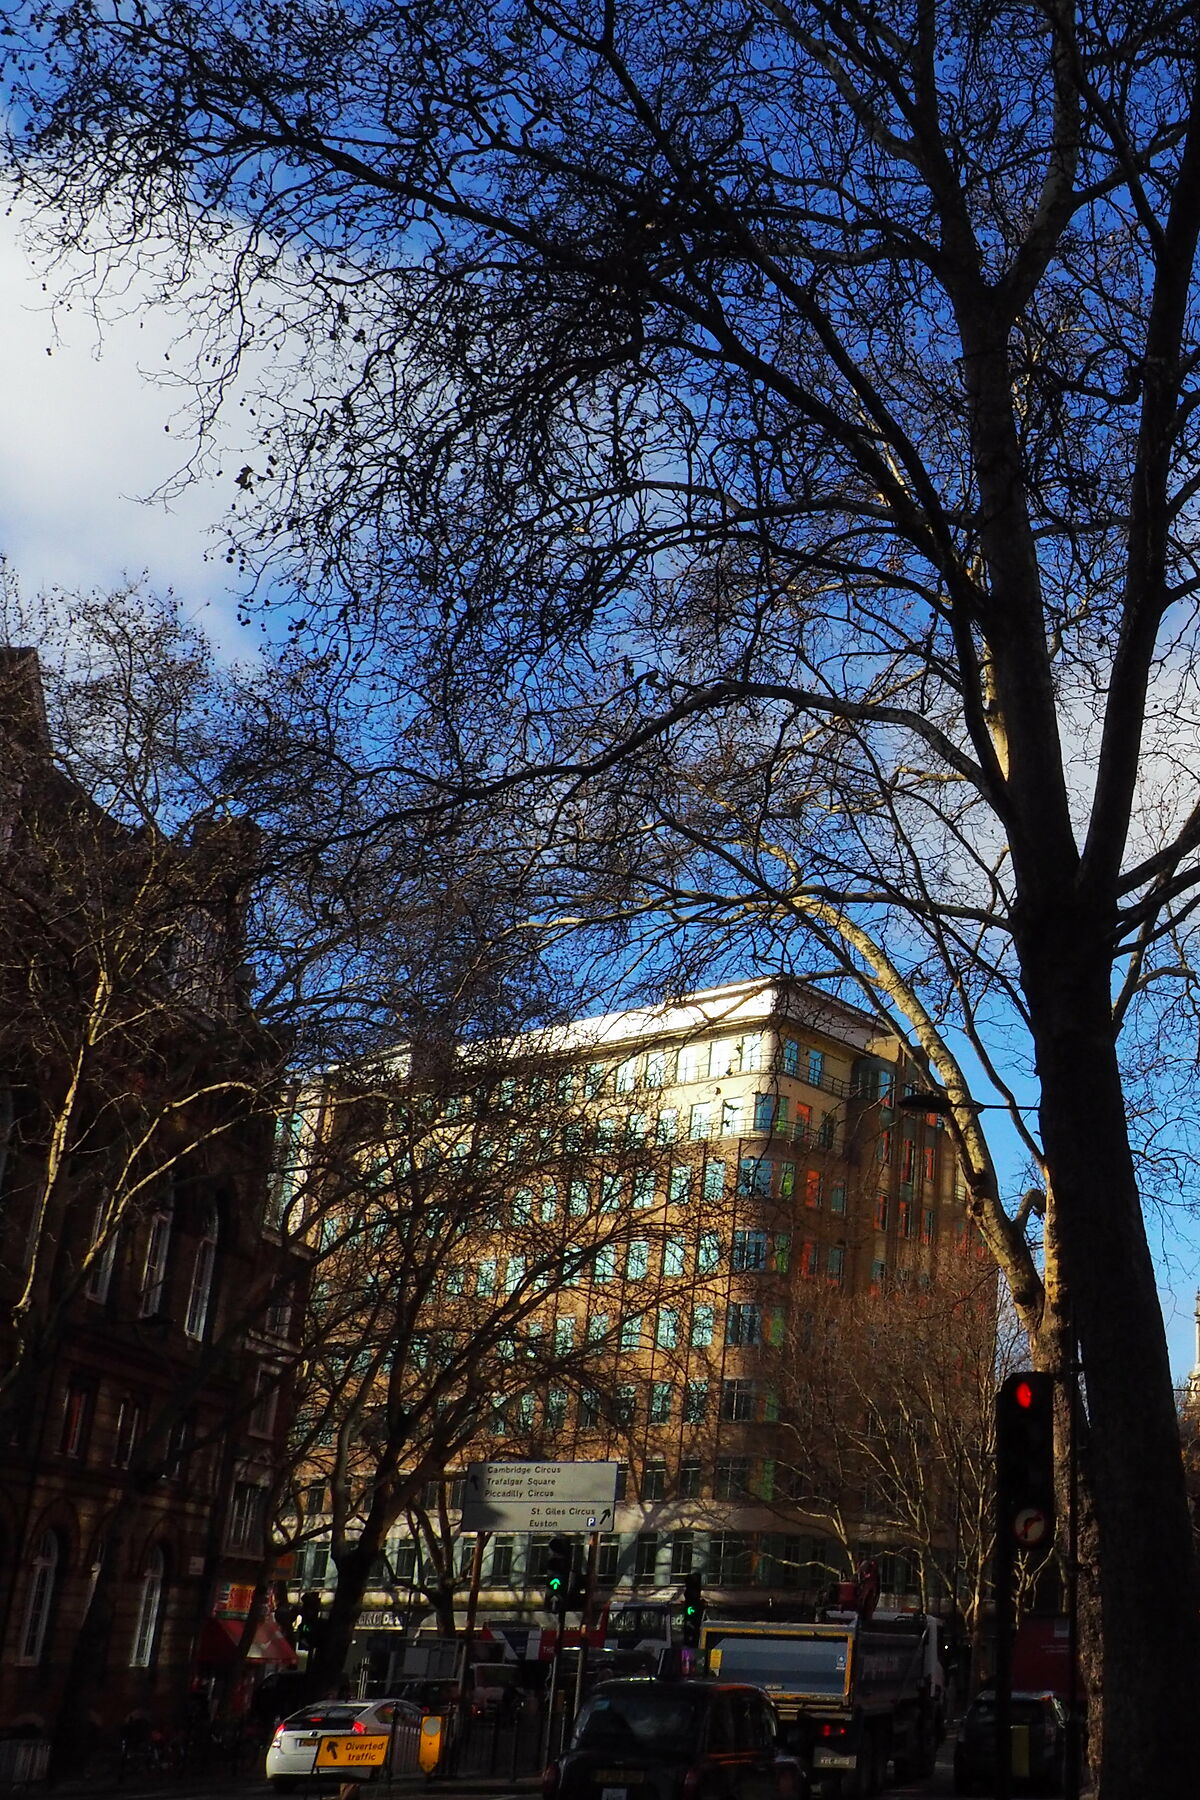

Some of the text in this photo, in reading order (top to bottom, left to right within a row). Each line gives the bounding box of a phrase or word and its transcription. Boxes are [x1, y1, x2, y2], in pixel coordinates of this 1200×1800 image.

[487, 1466, 561, 1474] Cambridge Circus
[487, 1478, 556, 1486] Trafalgar Square
[484, 1489, 554, 1498] Piccadilly Circus
[545, 1507, 566, 1515] Giles
[569, 1507, 596, 1515] Circus
[529, 1519, 558, 1527] Euston
[345, 1742, 385, 1751] Diverted
[348, 1753, 377, 1761] traffic
